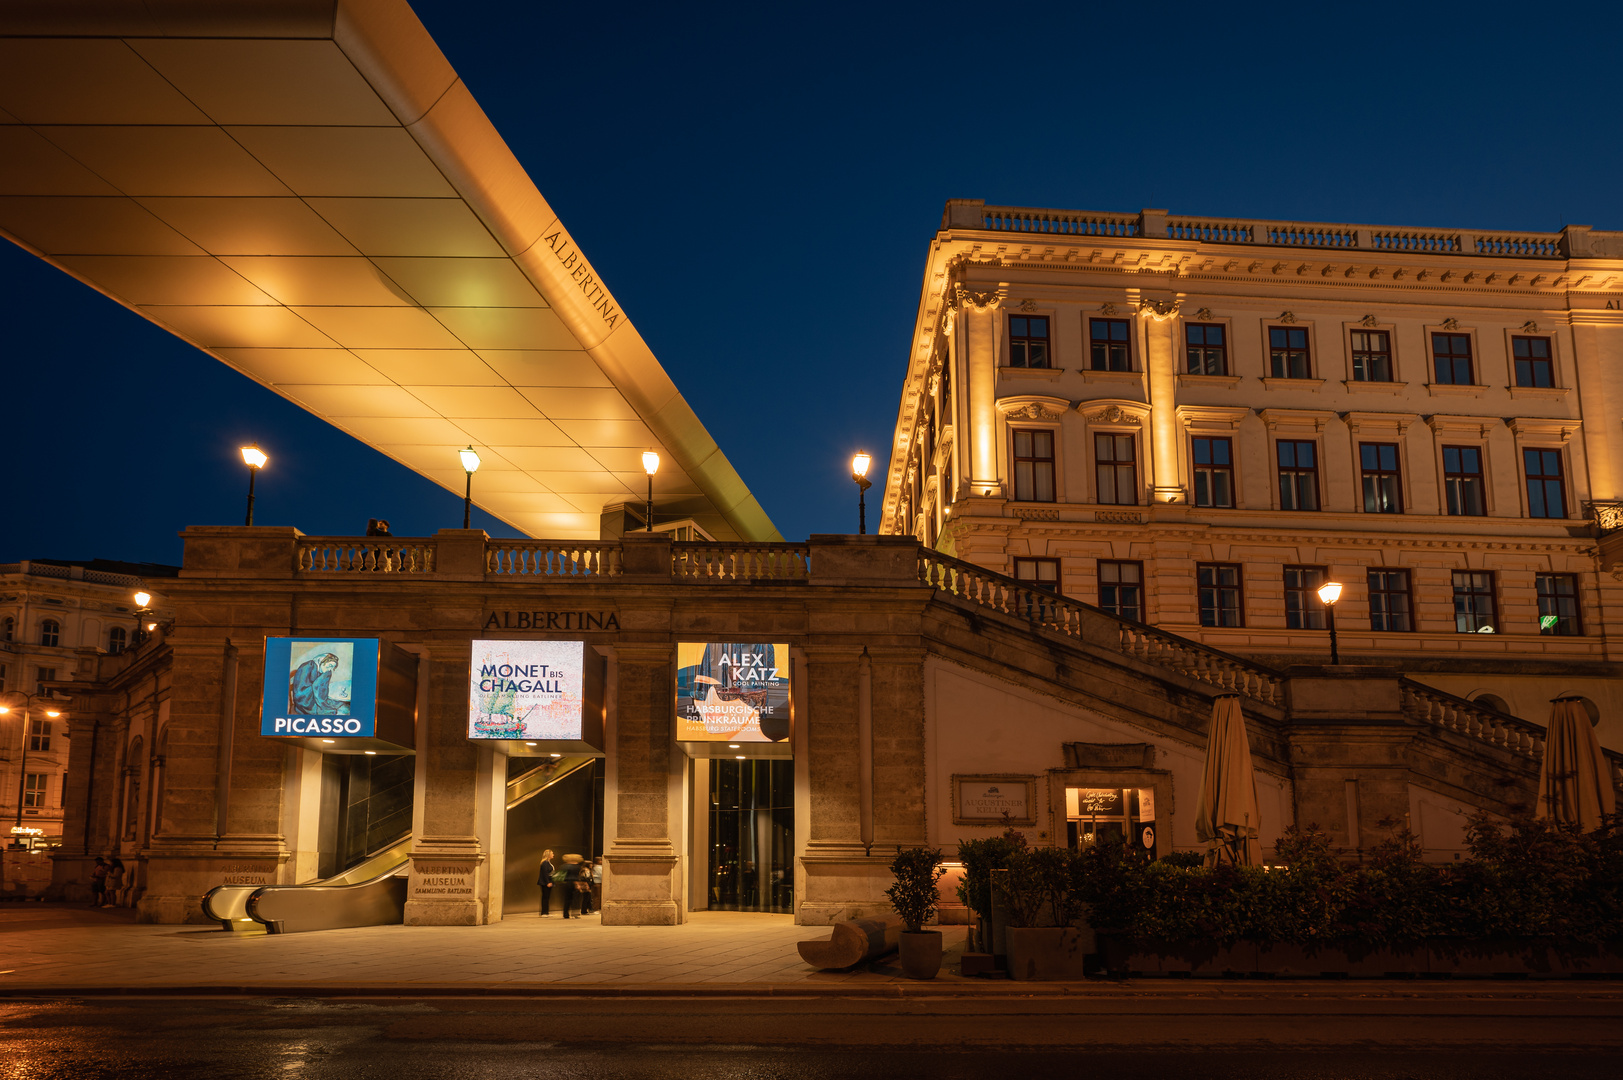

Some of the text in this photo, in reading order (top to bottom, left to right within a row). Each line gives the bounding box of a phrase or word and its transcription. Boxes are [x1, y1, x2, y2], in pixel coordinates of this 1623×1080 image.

[544, 231, 619, 330] ALBERTINA
[485, 611, 621, 630] ALBERTINA
[718, 653, 764, 667] ALEX
[480, 664, 549, 678] MONET
[732, 667, 780, 681] KATZ
[479, 679, 562, 693] CHAGALL
[686, 705, 774, 715] HABSBURGISCHE
[274, 718, 361, 734] PICASSO
[686, 713, 761, 725] PRUNKRÄUME
[976, 806, 1012, 814] KELLER
[419, 866, 471, 875] ALBERTINA
[223, 875, 267, 885] MUSEUM
[422, 877, 466, 886] MUSEUM
